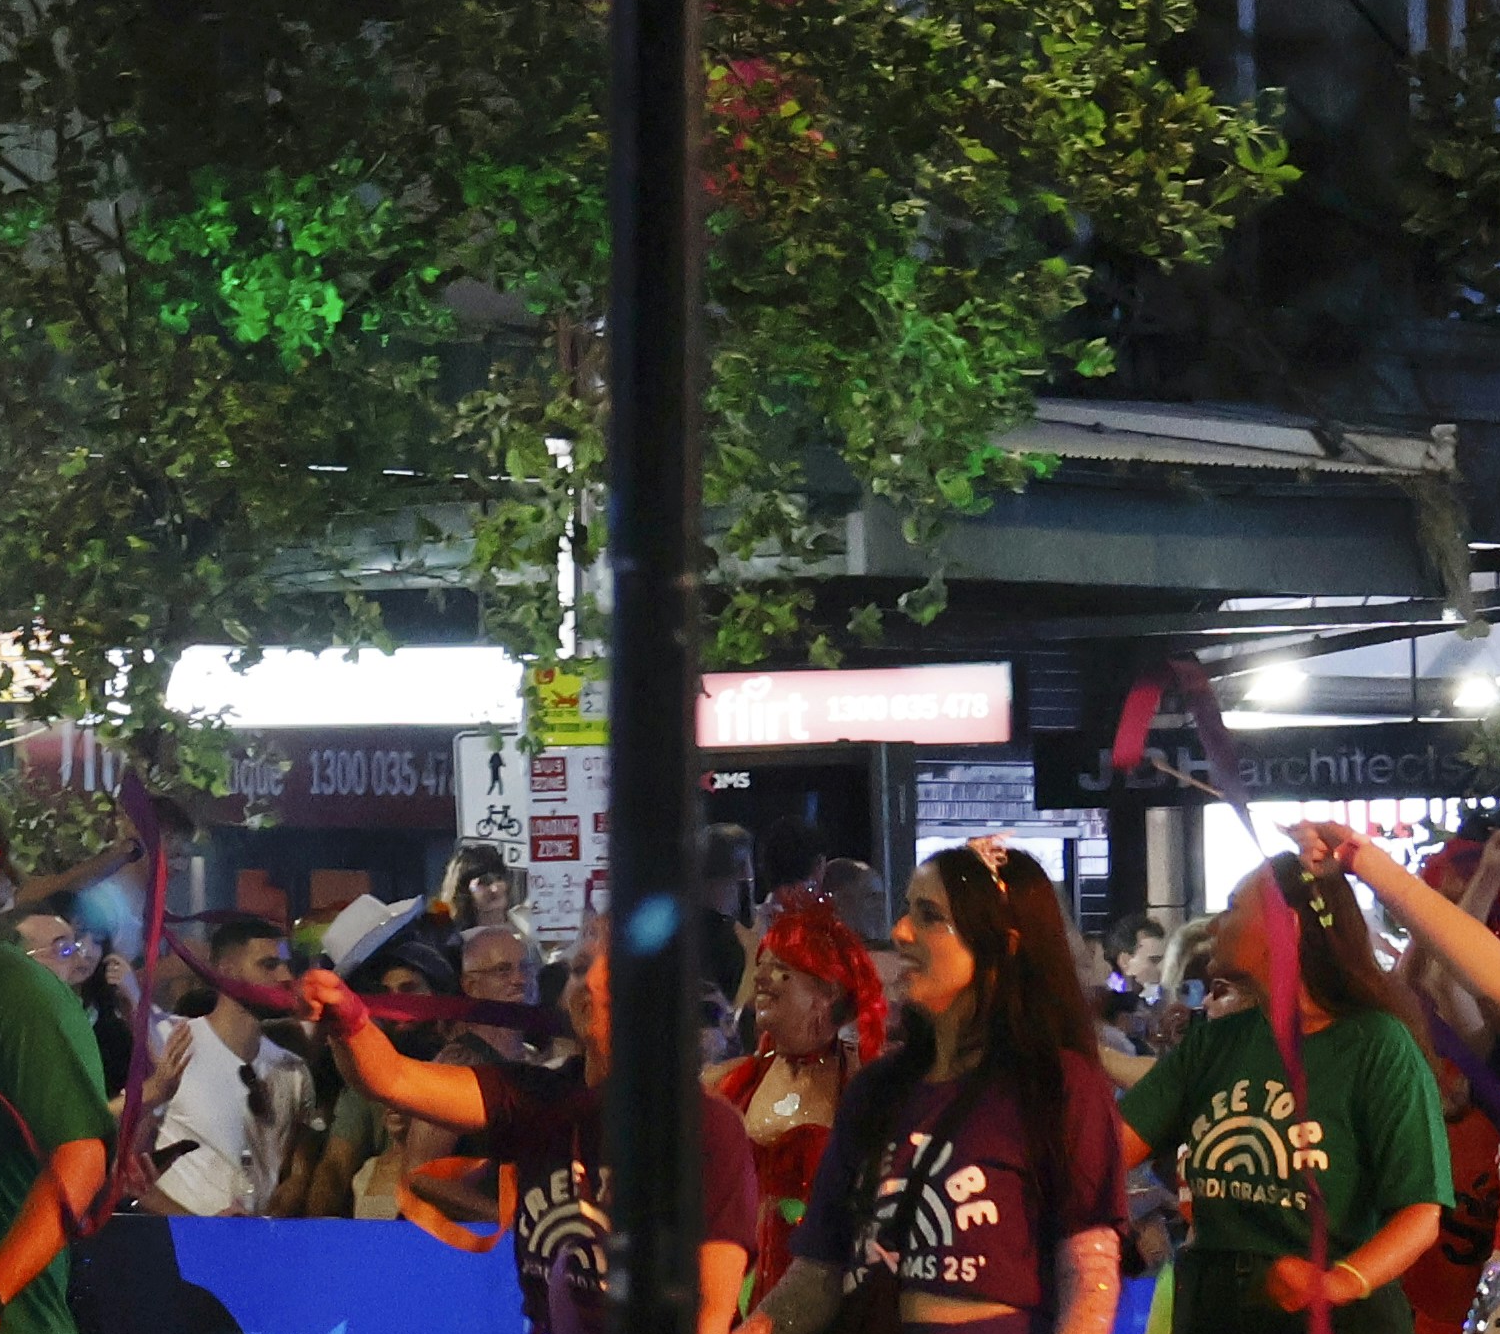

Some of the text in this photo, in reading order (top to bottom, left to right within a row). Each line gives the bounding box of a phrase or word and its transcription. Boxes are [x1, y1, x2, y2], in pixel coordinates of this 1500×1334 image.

[713, 685, 810, 742] flirt
[309, 749, 367, 795] 1300
[420, 750, 454, 797] 47
[1263, 1079, 1297, 1121] TO
[1286, 1120, 1330, 1171] BE
[945, 1163, 999, 1233] BE
